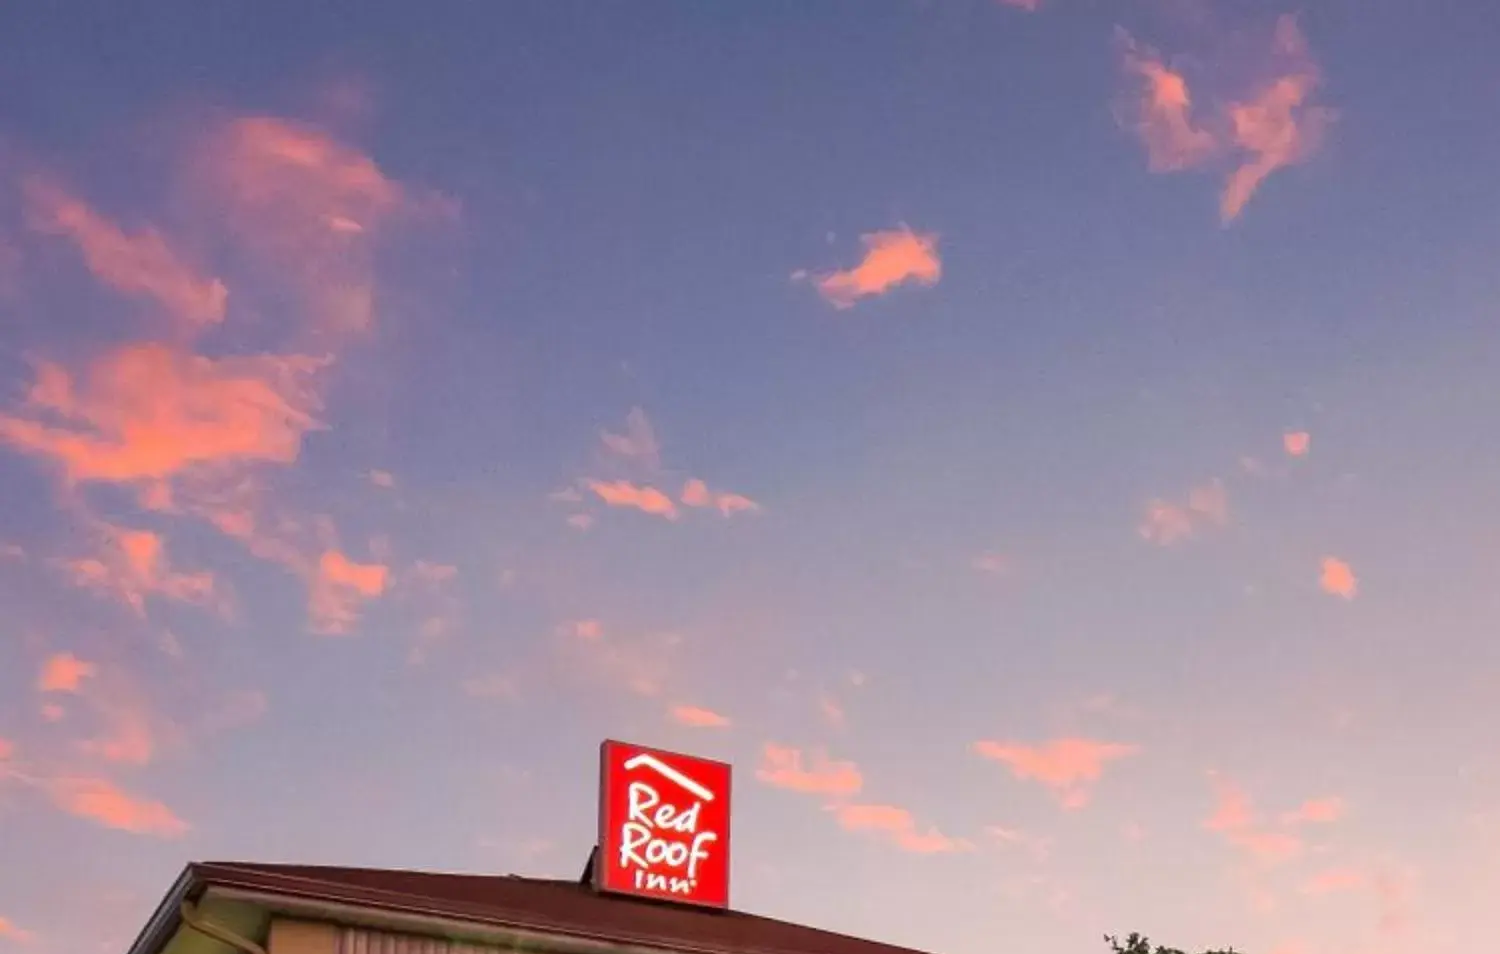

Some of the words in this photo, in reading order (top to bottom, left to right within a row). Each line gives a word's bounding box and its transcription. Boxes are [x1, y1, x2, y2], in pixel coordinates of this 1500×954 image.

[629, 782, 701, 834] Red
[620, 822, 717, 878] Roof
[634, 870, 692, 895] Inn
